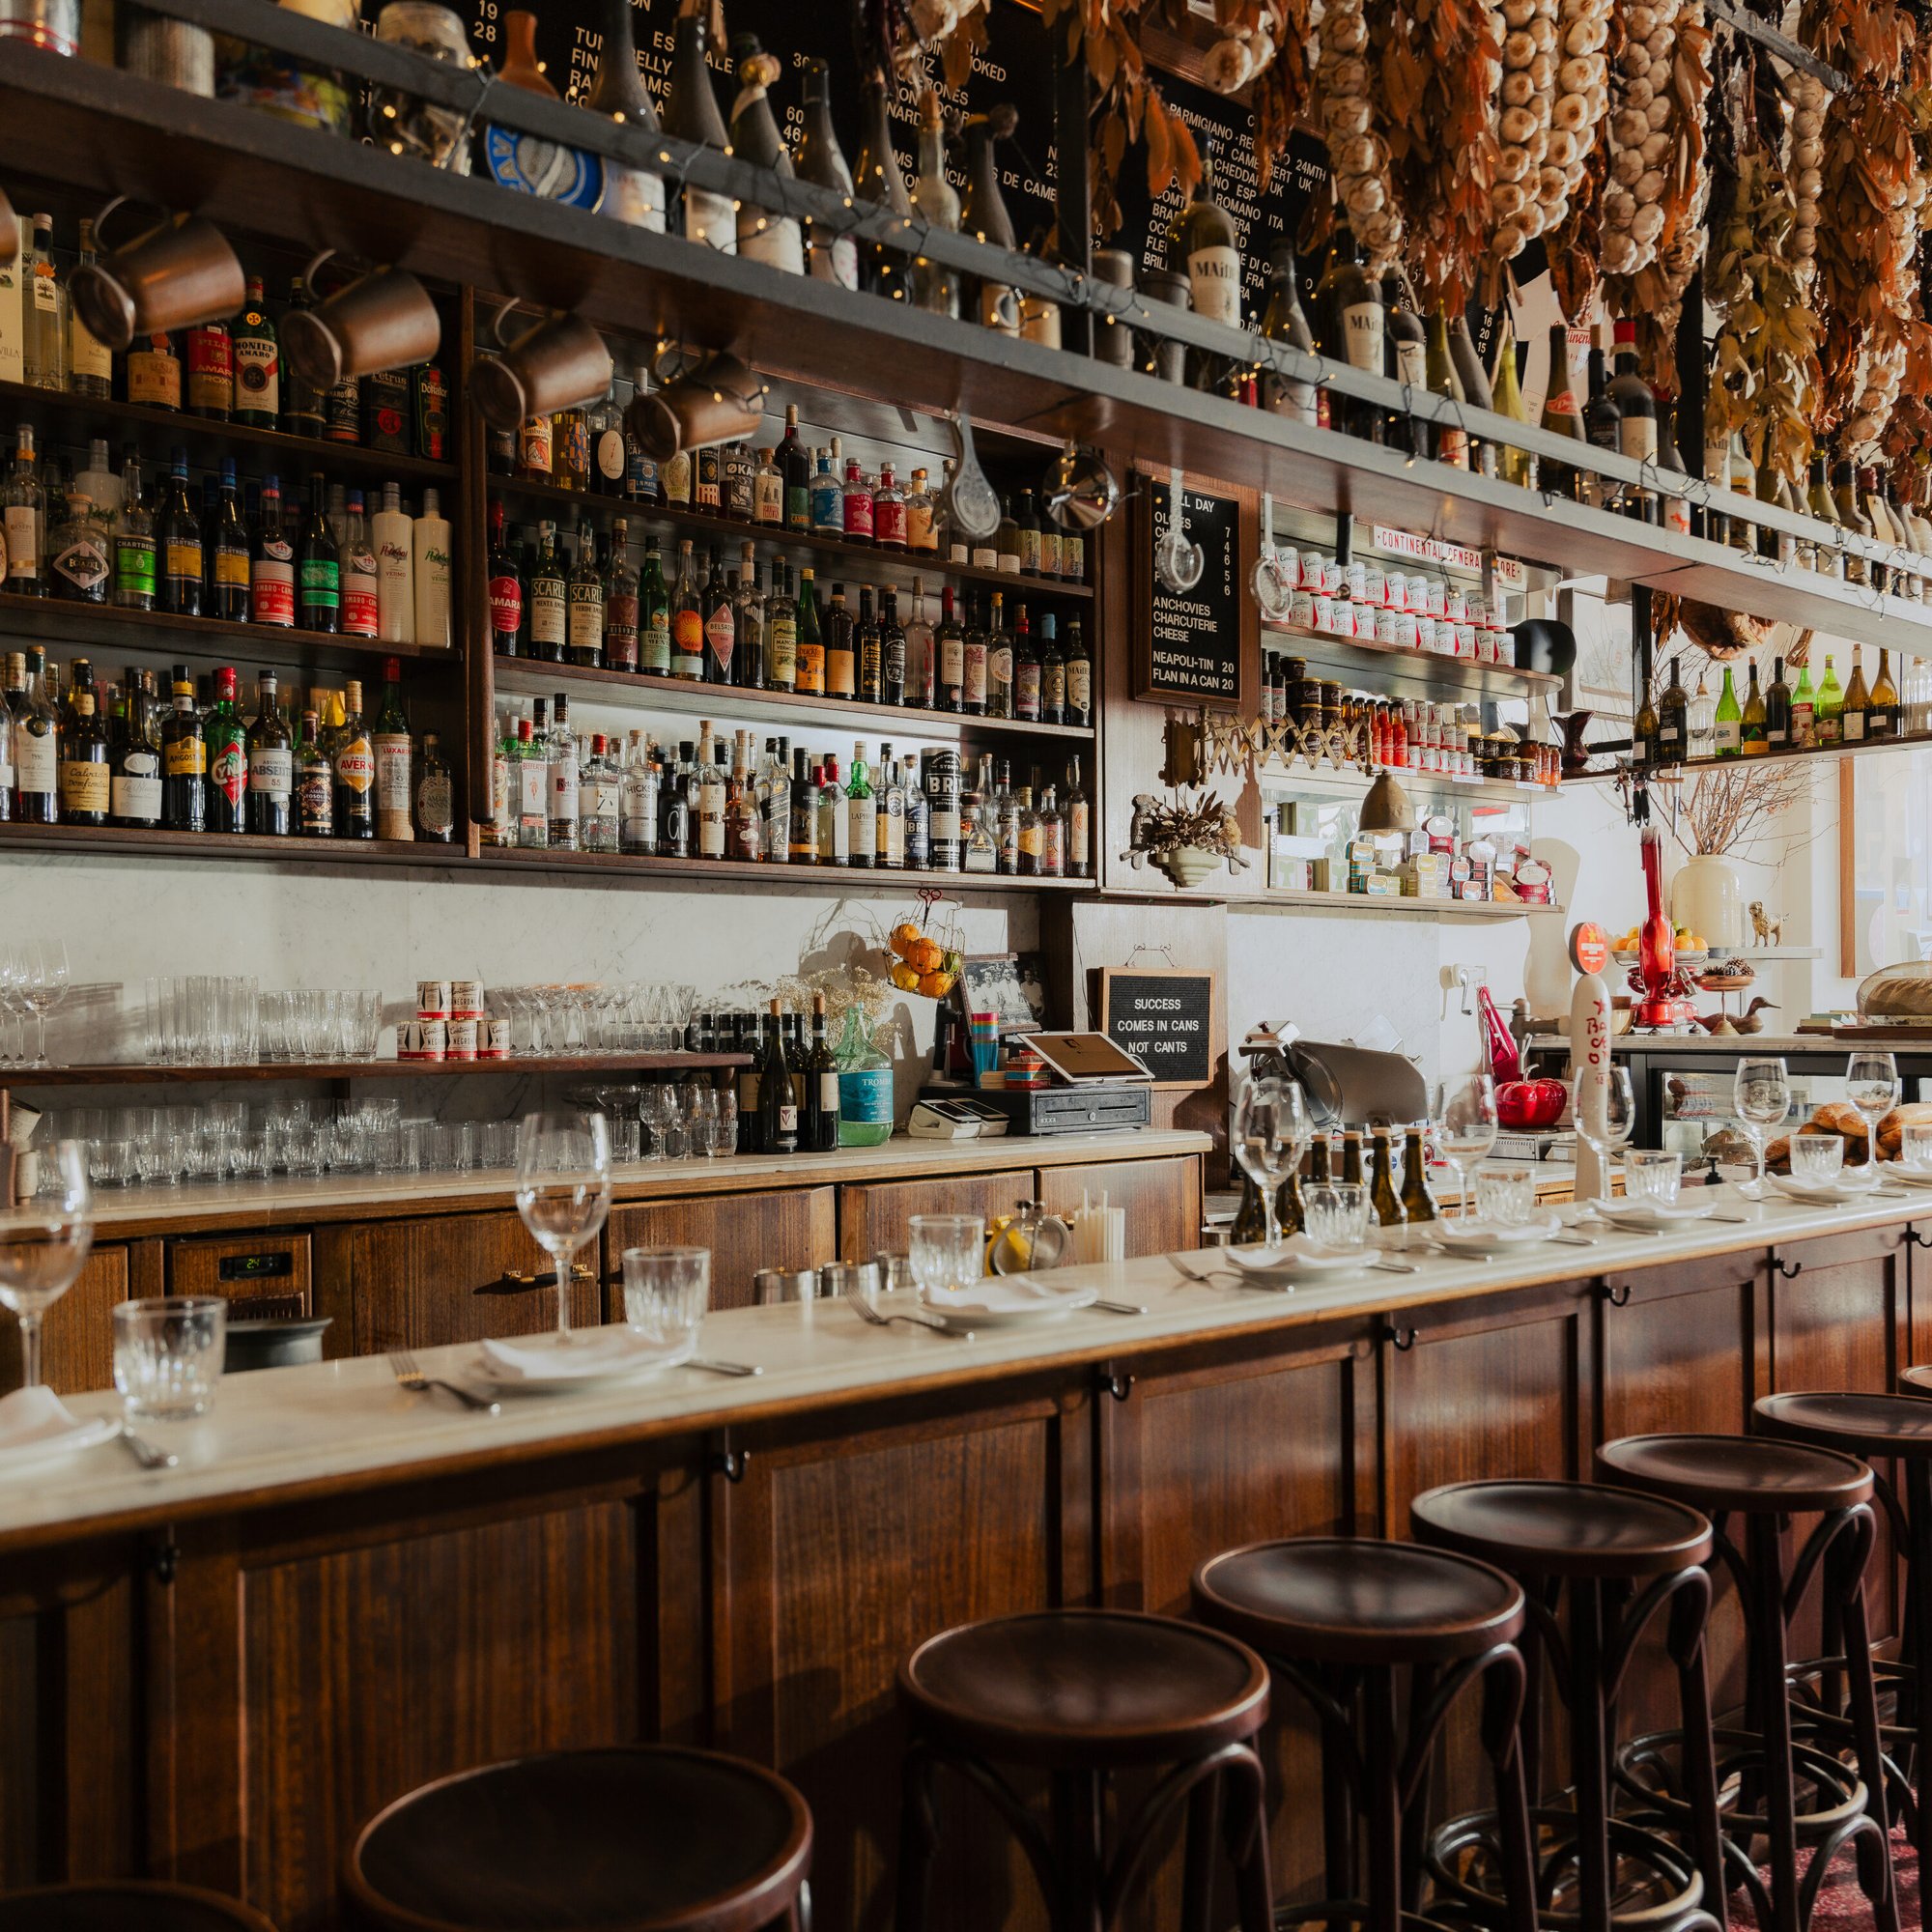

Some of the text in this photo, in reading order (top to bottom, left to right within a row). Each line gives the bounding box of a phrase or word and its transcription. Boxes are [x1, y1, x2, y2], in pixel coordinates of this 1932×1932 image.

[473, 21, 497, 43] 28
[969, 55, 1007, 83] OKED
[786, 106, 805, 125] 60
[783, 125, 802, 142] 46
[1170, 103, 1233, 141] PARMIGIANO
[1295, 158, 1326, 182] 24MTH
[1004, 171, 1019, 188] DE
[1298, 176, 1313, 192] UK
[1236, 185, 1257, 201] ESP
[1269, 181, 1285, 197] UK
[1215, 193, 1284, 231] ROMANO ITA
[1146, 235, 1167, 253] FLE
[1246, 272, 1264, 290] FRA
[1483, 314, 1492, 327] 16
[1479, 328, 1490, 340] 20
[1477, 342, 1487, 354] 15
[1196, 497, 1215, 513] DAY
[1154, 511, 1192, 529] OLES
[1225, 527, 1231, 538] 7
[1224, 541, 1231, 553] 4
[1382, 531, 1516, 578] CONTINENTAL GENERA TORE
[1224, 554, 1231, 566] 6
[1224, 570, 1231, 582] 5
[1224, 584, 1231, 596] 6
[489, 597, 521, 611] AMARA
[1153, 596, 1211, 617] ANCHOVIES
[1153, 611, 1218, 633] CHARCUTERIE
[1153, 626, 1190, 642] CHEESE
[1153, 650, 1235, 674] NEAPOLI-TIN 20
[1153, 668, 1235, 691] FLAN IN A CAN 20
[1135, 999, 1181, 1009] SUCCESS
[1118, 1020, 1199, 1032] COMES IN CANS
[1128, 1041, 1187, 1053] NOT CANTS
